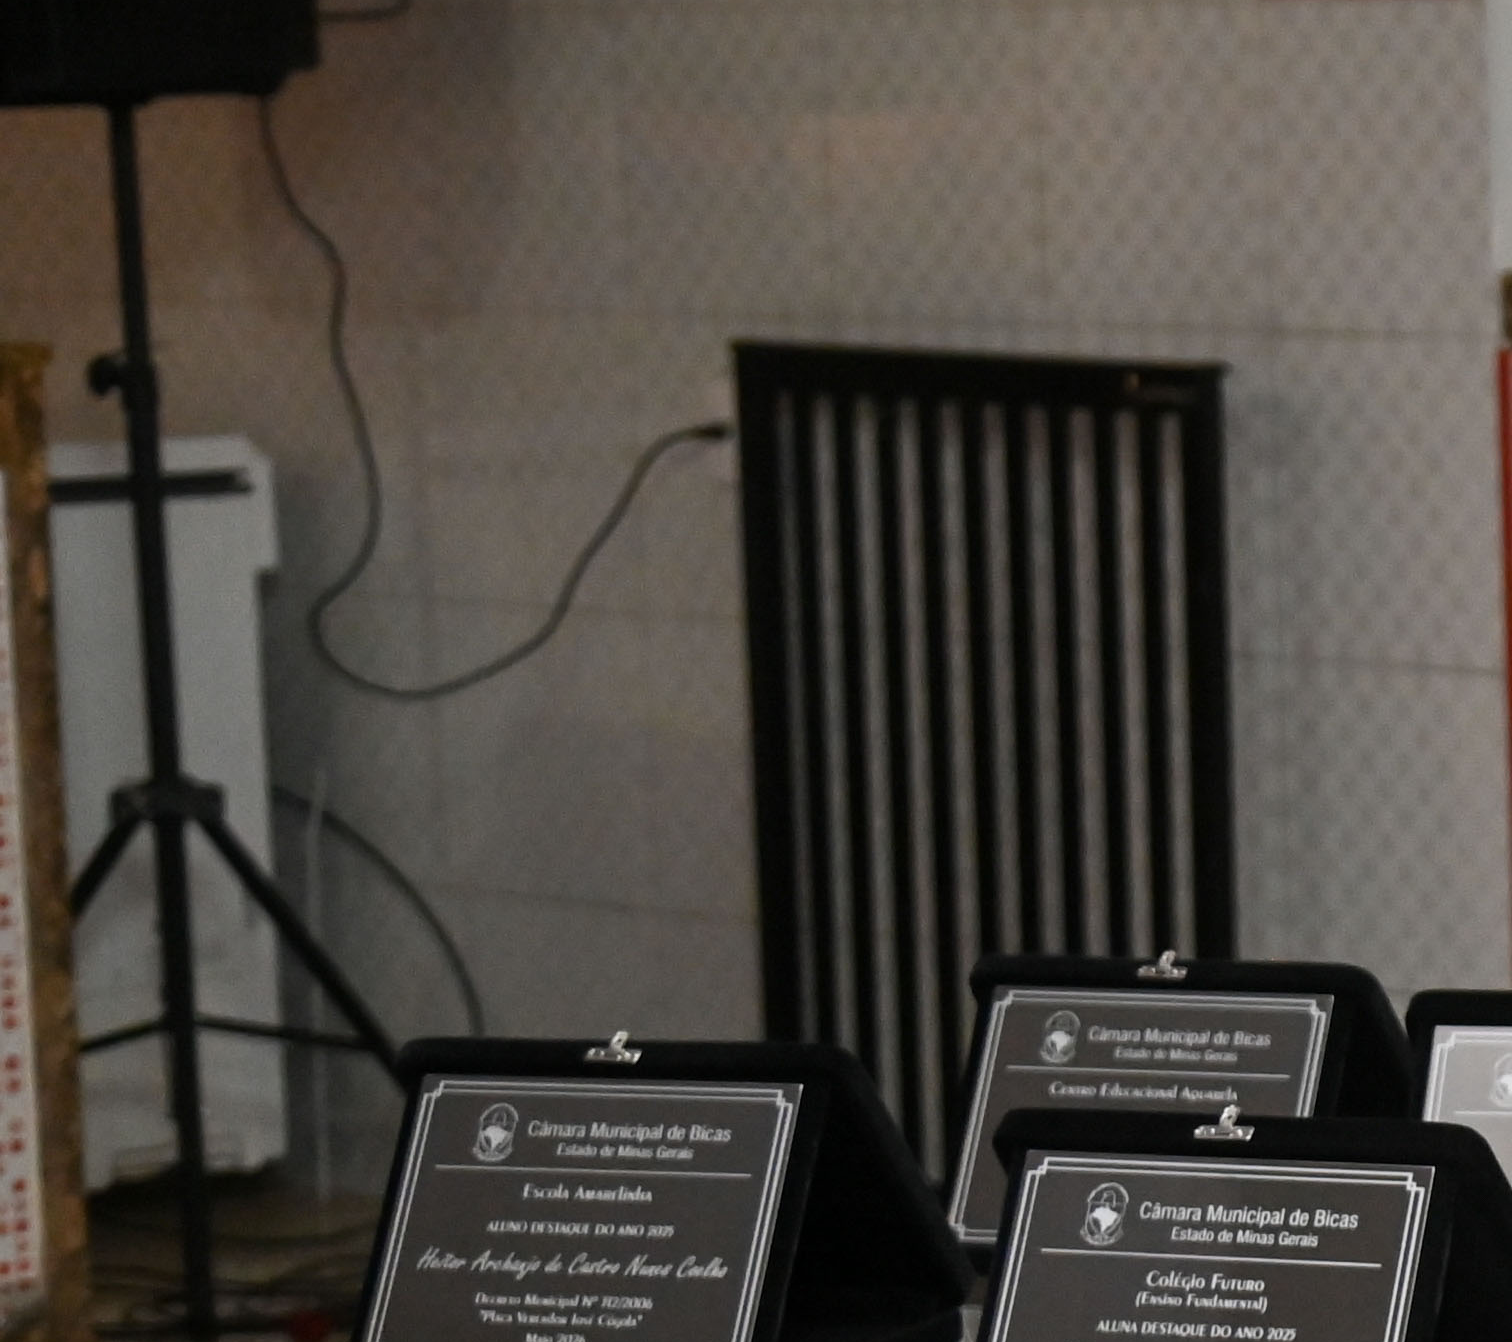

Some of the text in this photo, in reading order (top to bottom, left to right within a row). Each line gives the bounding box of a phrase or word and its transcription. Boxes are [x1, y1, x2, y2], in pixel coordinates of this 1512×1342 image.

[1139, 1201, 1359, 1230] Câmara Municipal de Bicas
[1170, 1226, 1319, 1248] Estado de Minas Gerais
[1146, 1270, 1265, 1292] Colégio Futuro
[1135, 1291, 1268, 1314] (Ensino Fundamental)
[1096, 1319, 1297, 1342] ALUNA DESTAQUE DO ANO 2025
